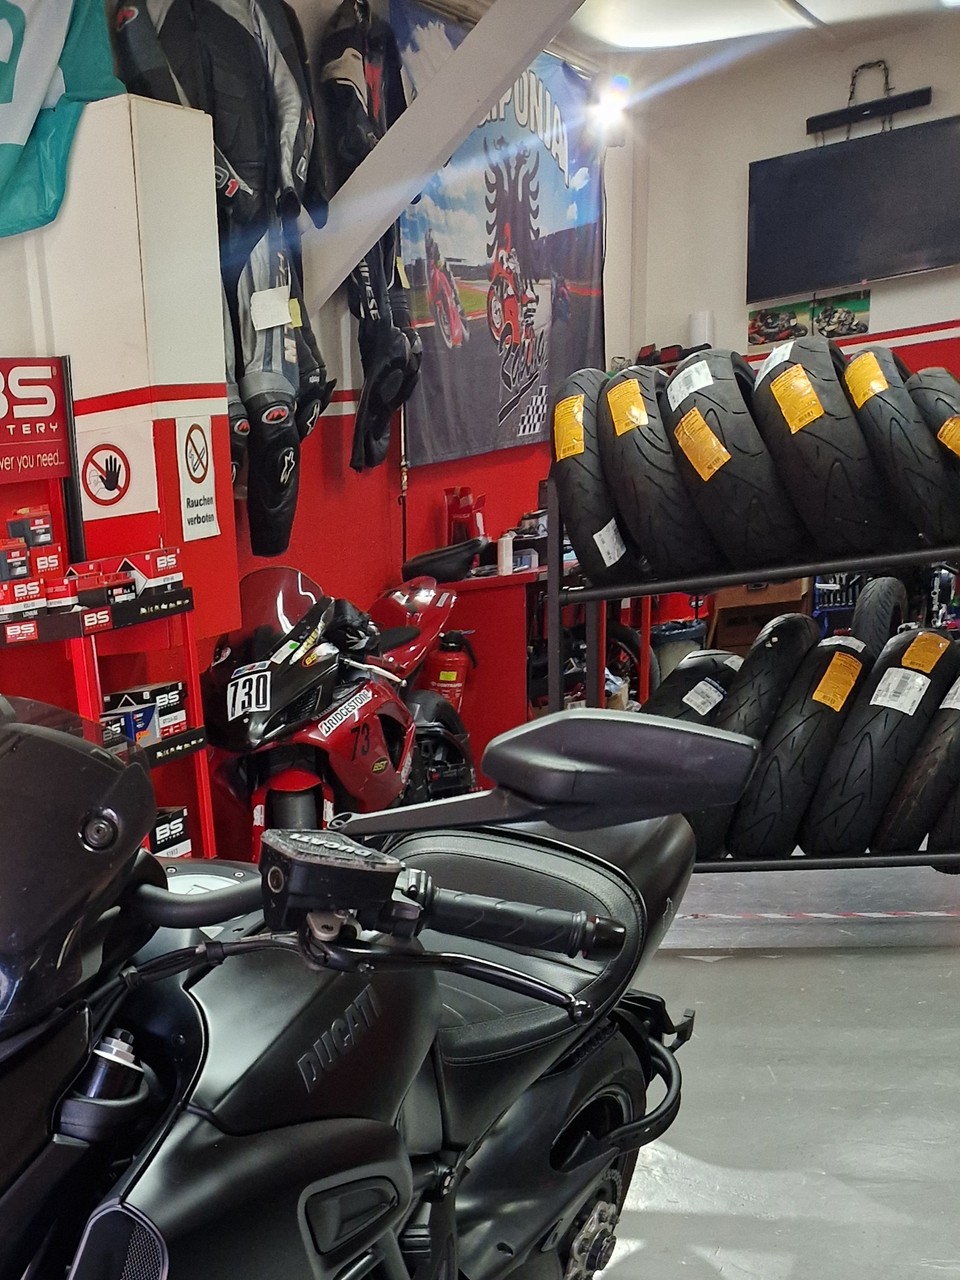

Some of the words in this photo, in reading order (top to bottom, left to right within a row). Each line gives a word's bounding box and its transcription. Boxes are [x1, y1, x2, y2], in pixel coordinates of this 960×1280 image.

[16, 454, 34, 473] you
[186, 495, 214, 508] Rauchen
[186, 513, 215, 526] verboten
[36, 554, 59, 570] BS
[156, 554, 177, 569] BS
[13, 581, 40, 598] BS
[84, 610, 110, 627] BS
[6, 623, 35, 636] BS
[155, 690, 180, 707] BS
[230, 674, 268, 718] 730
[320, 689, 373, 736] BRIDGESTONE
[155, 817, 184, 841] BS
[289, 832, 373, 857] DUCATI
[296, 983, 381, 1094] DUCATI
